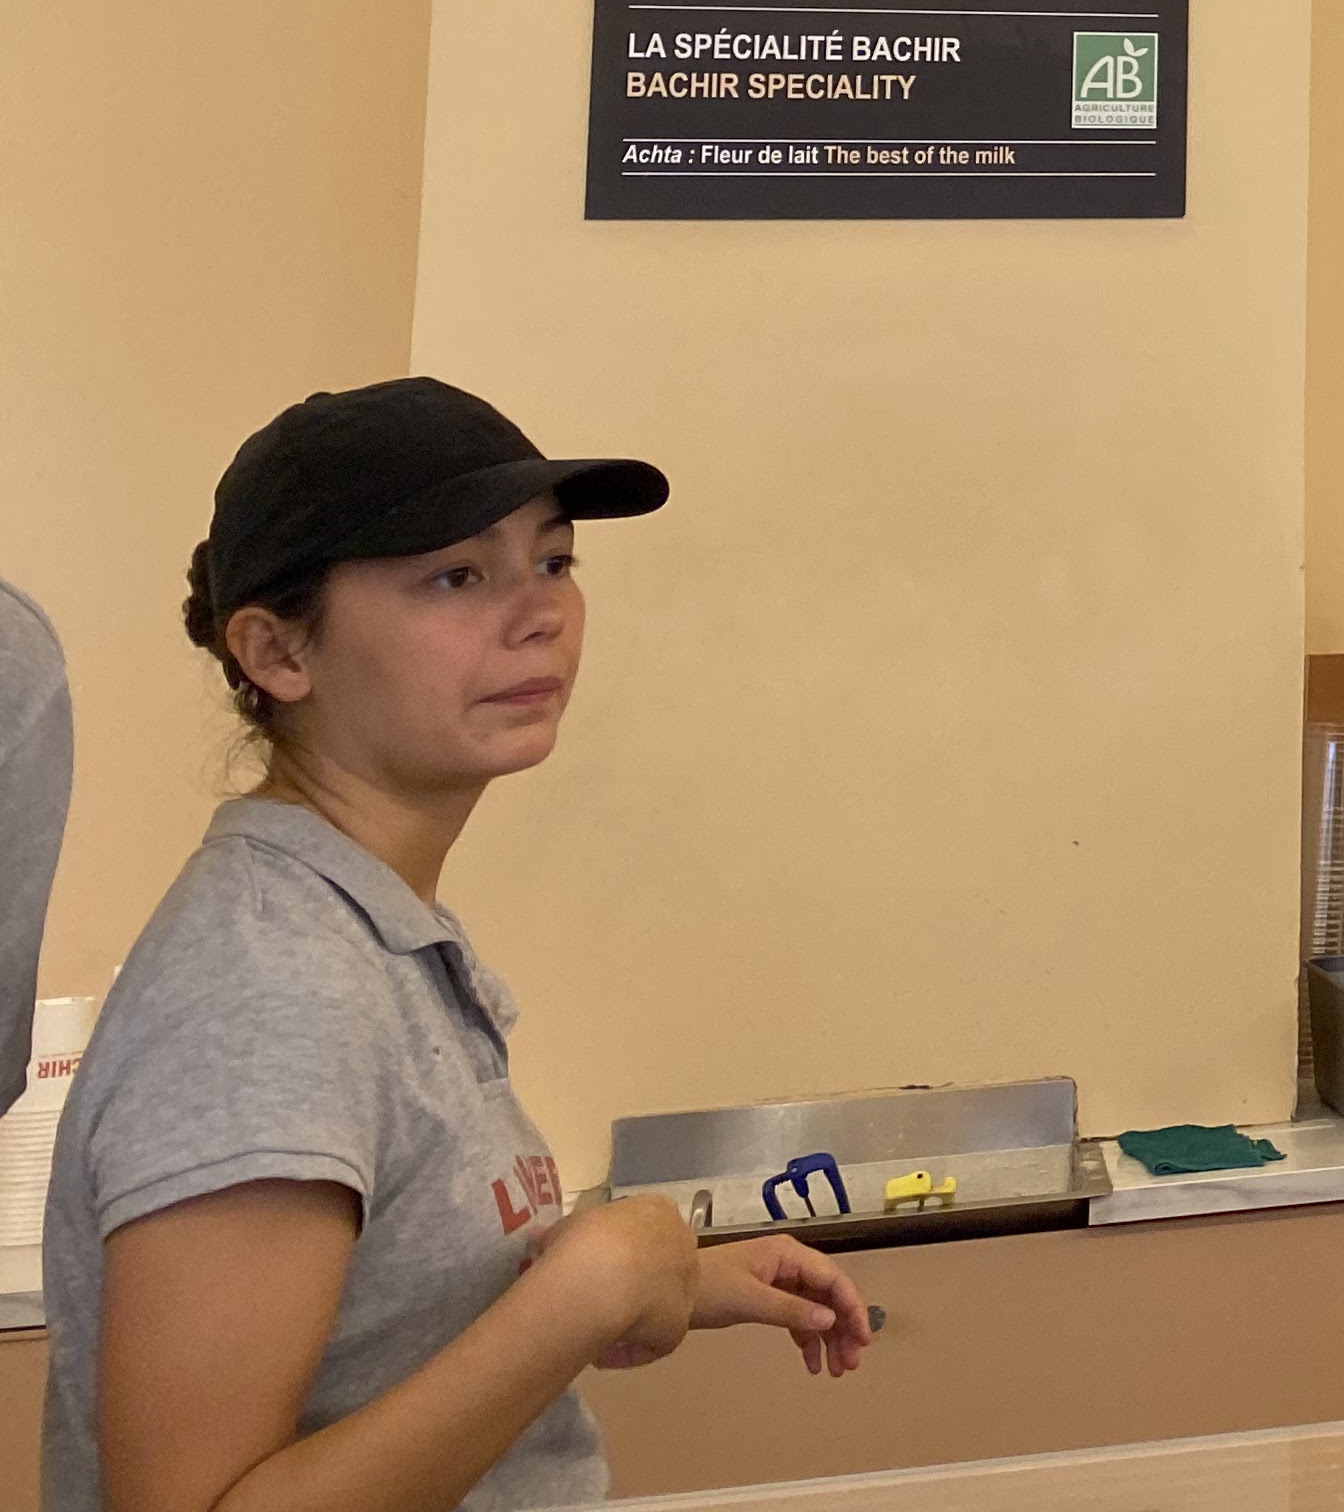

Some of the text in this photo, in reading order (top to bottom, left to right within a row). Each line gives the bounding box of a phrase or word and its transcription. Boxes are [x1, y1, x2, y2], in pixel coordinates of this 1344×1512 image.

[628, 27, 961, 63] LA SPÉCIALITÉ BACHIR
[626, 71, 917, 100] BACHIR SPECIALITY
[1080, 54, 1143, 99] AB
[1074, 103, 1155, 113] AGRICULTURE
[1074, 114, 1155, 124] BIOLOGIQUE
[621, 144, 683, 164] Achta
[700, 144, 754, 165] Fleur
[757, 144, 783, 165] de
[788, 144, 820, 165] lait
[823, 145, 861, 165] The
[866, 145, 910, 165] best
[913, 145, 935, 165] of
[938, 145, 970, 165] the
[975, 145, 1016, 165] milk
